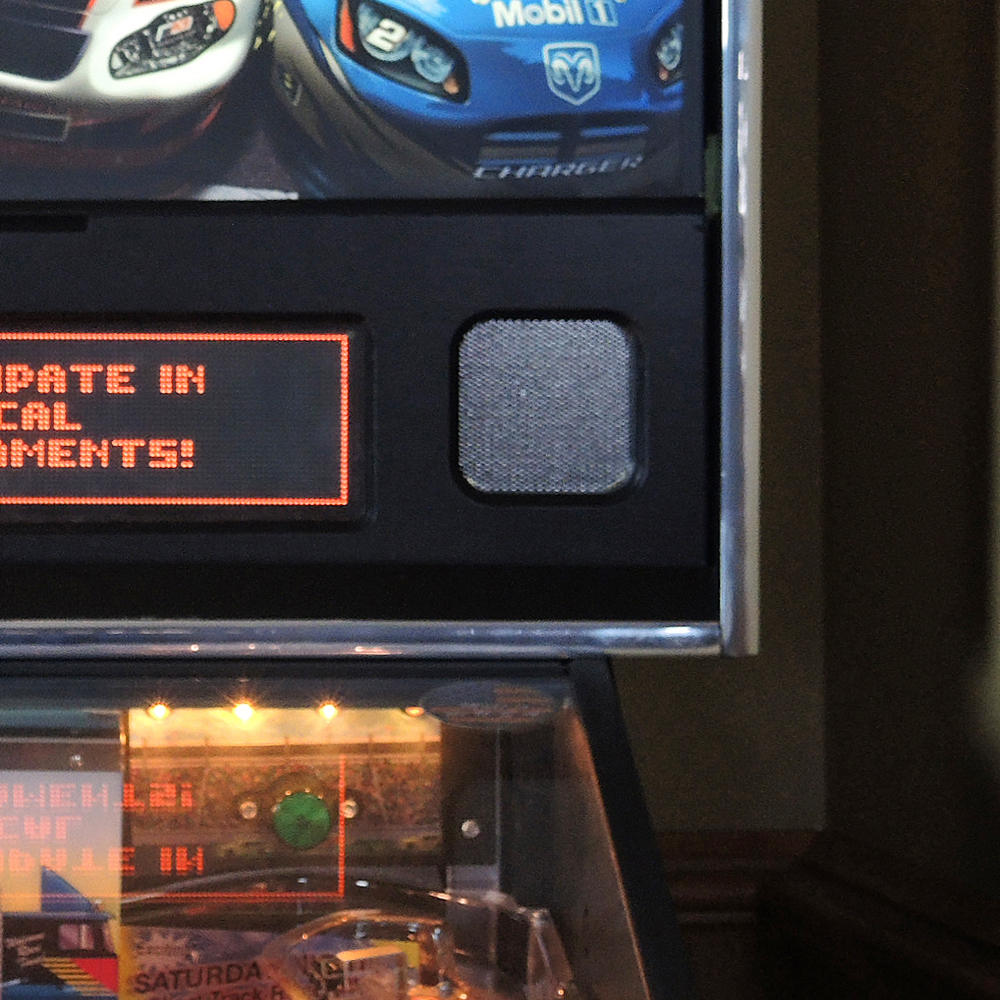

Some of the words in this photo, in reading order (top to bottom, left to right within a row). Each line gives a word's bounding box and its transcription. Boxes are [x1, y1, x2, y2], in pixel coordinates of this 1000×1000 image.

[365, 18, 408, 52] 2
[159, 363, 206, 394] IN
[134, 960, 262, 994] SATURDA
